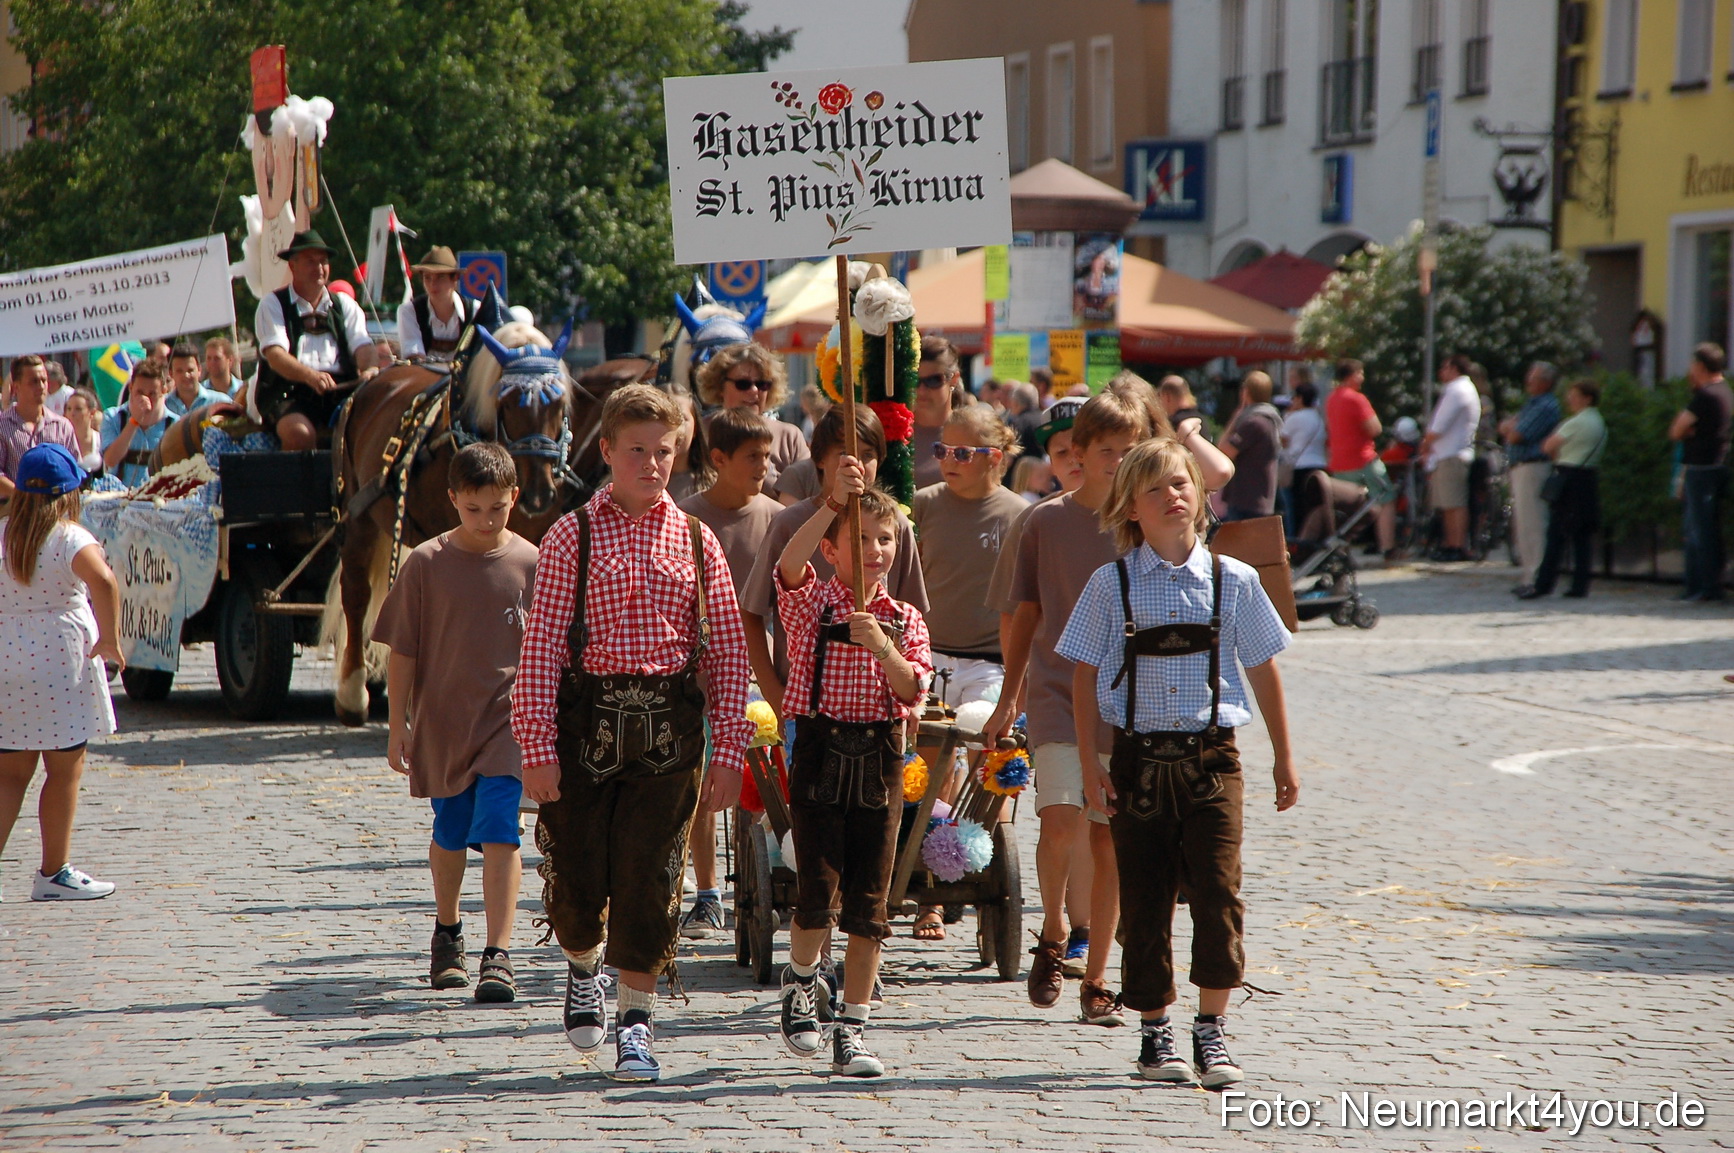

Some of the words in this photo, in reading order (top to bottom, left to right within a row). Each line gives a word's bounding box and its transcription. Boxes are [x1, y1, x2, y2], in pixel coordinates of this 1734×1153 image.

[692, 100, 984, 171] Hasenheider
[695, 178, 755, 218] St.
[768, 173, 855, 223] Pius
[869, 168, 986, 208] Kirwa
[64, 246, 208, 278] Schmankerlwochen
[25, 287, 72, 305] 01.10.
[88, 270, 170, 295] 31.10.2013
[34, 310, 78, 326] Unser
[82, 301, 134, 319] Motto:
[125, 543, 141, 587] St.
